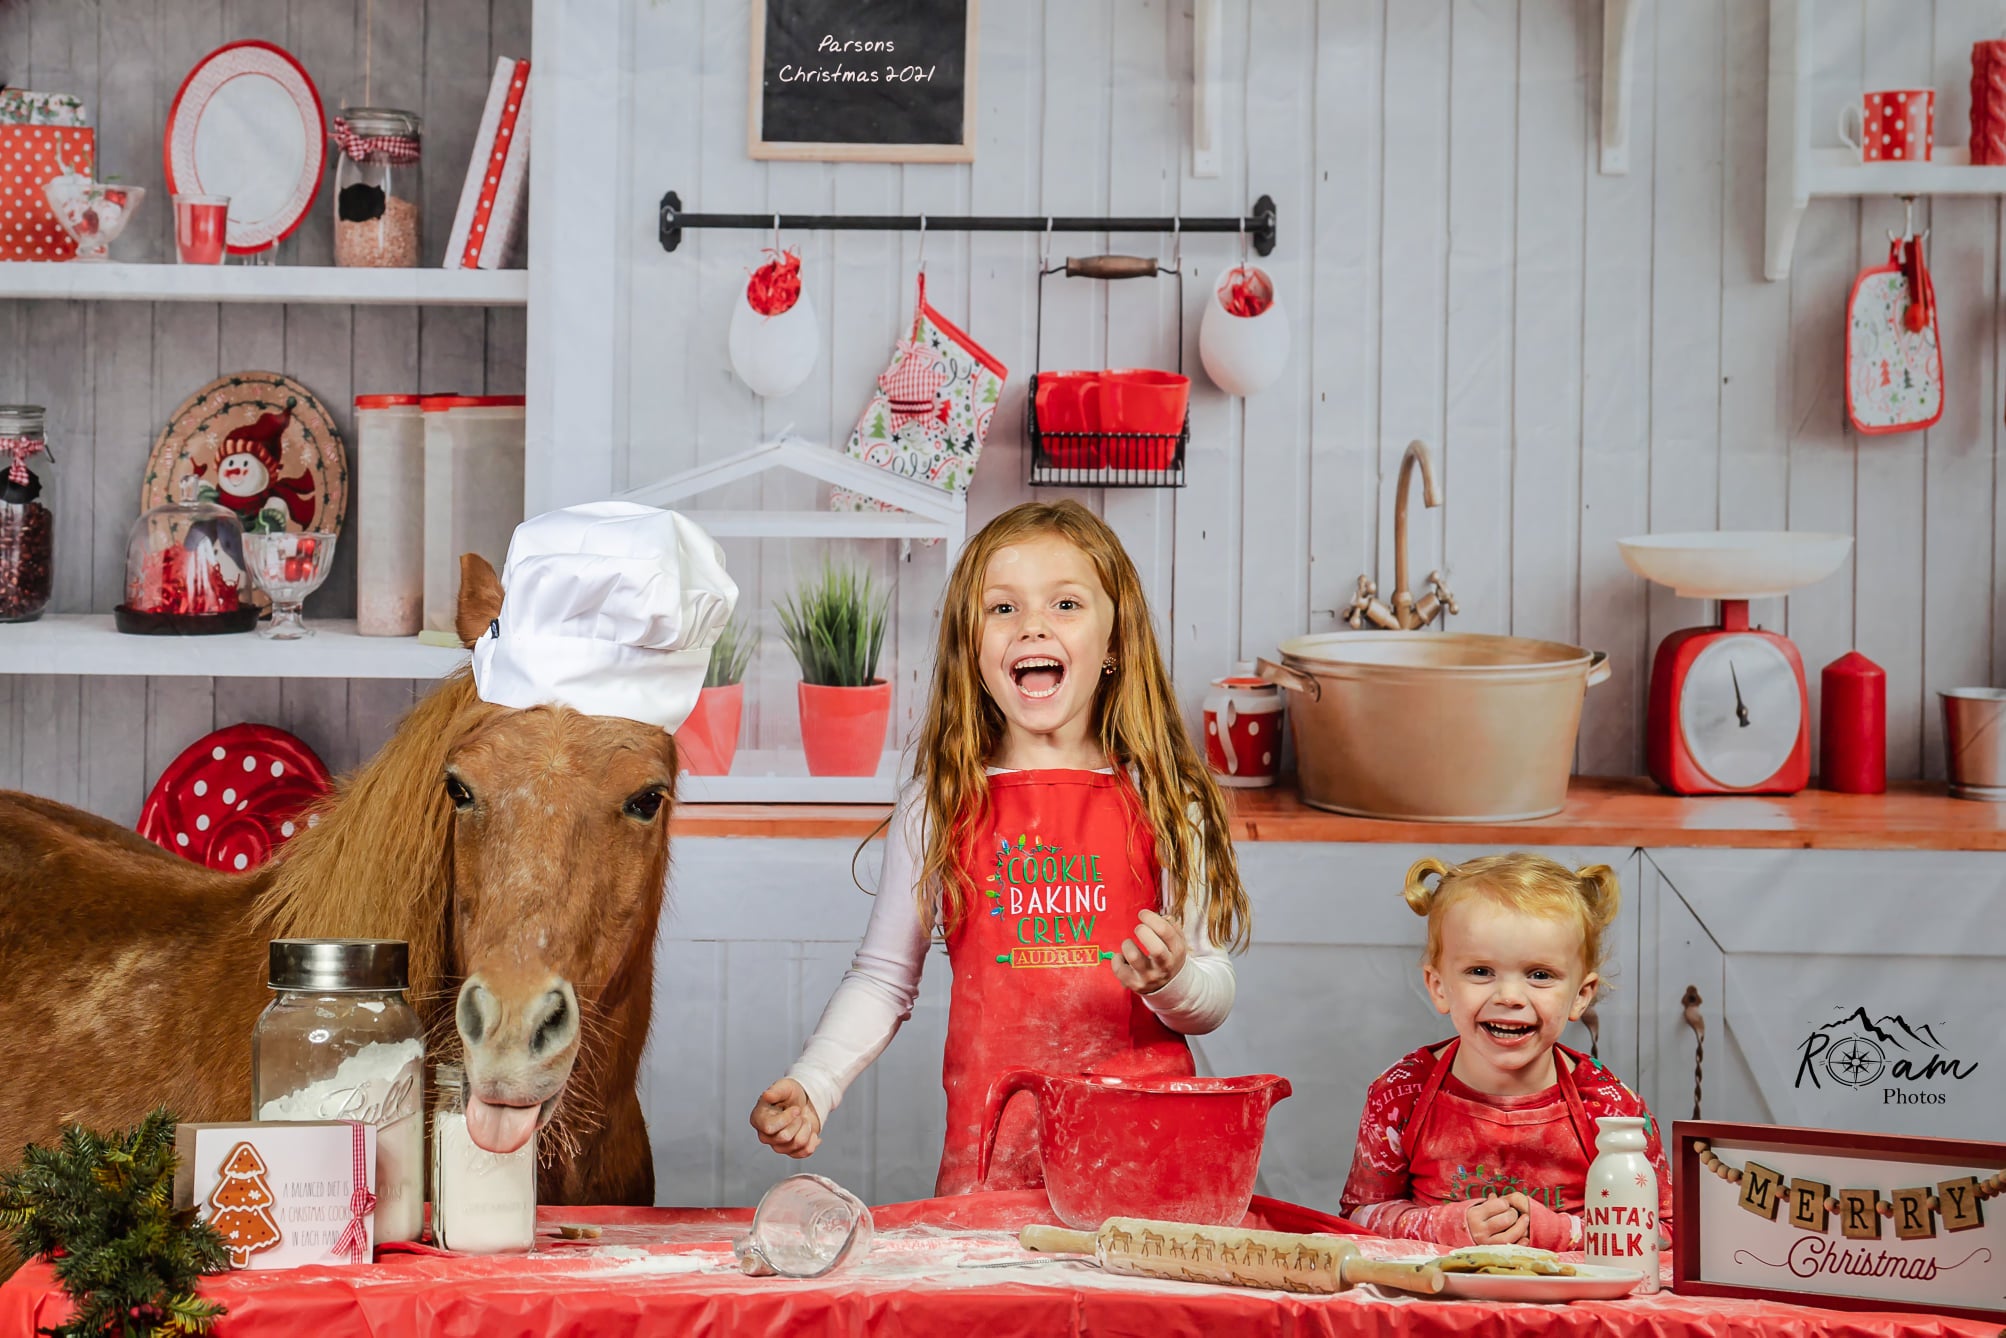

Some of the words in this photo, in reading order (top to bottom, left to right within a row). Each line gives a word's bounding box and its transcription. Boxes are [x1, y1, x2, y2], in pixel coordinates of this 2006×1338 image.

[818, 34, 895, 52] Parsons
[778, 63, 880, 82] Christmas
[885, 65, 936, 82] 2021
[1007, 855, 1103, 884] COOKIE
[1010, 885, 1107, 915] BAKING
[1017, 915, 1097, 944] CREW
[1016, 948, 1096, 966] AUDREY
[283, 1183, 288, 1198] A
[292, 1181, 324, 1198] BALANCED
[327, 1181, 341, 1197] DIET
[343, 1182, 349, 1196] IS
[1745, 1171, 1966, 1230] MERRY
[288, 1206, 325, 1223] CHRISTMAS
[1587, 1207, 1654, 1230] ANTA'S
[301, 1230, 319, 1247] EACH
[1587, 1232, 1643, 1257] MILK
[1788, 1236, 1938, 1281] Christmas
